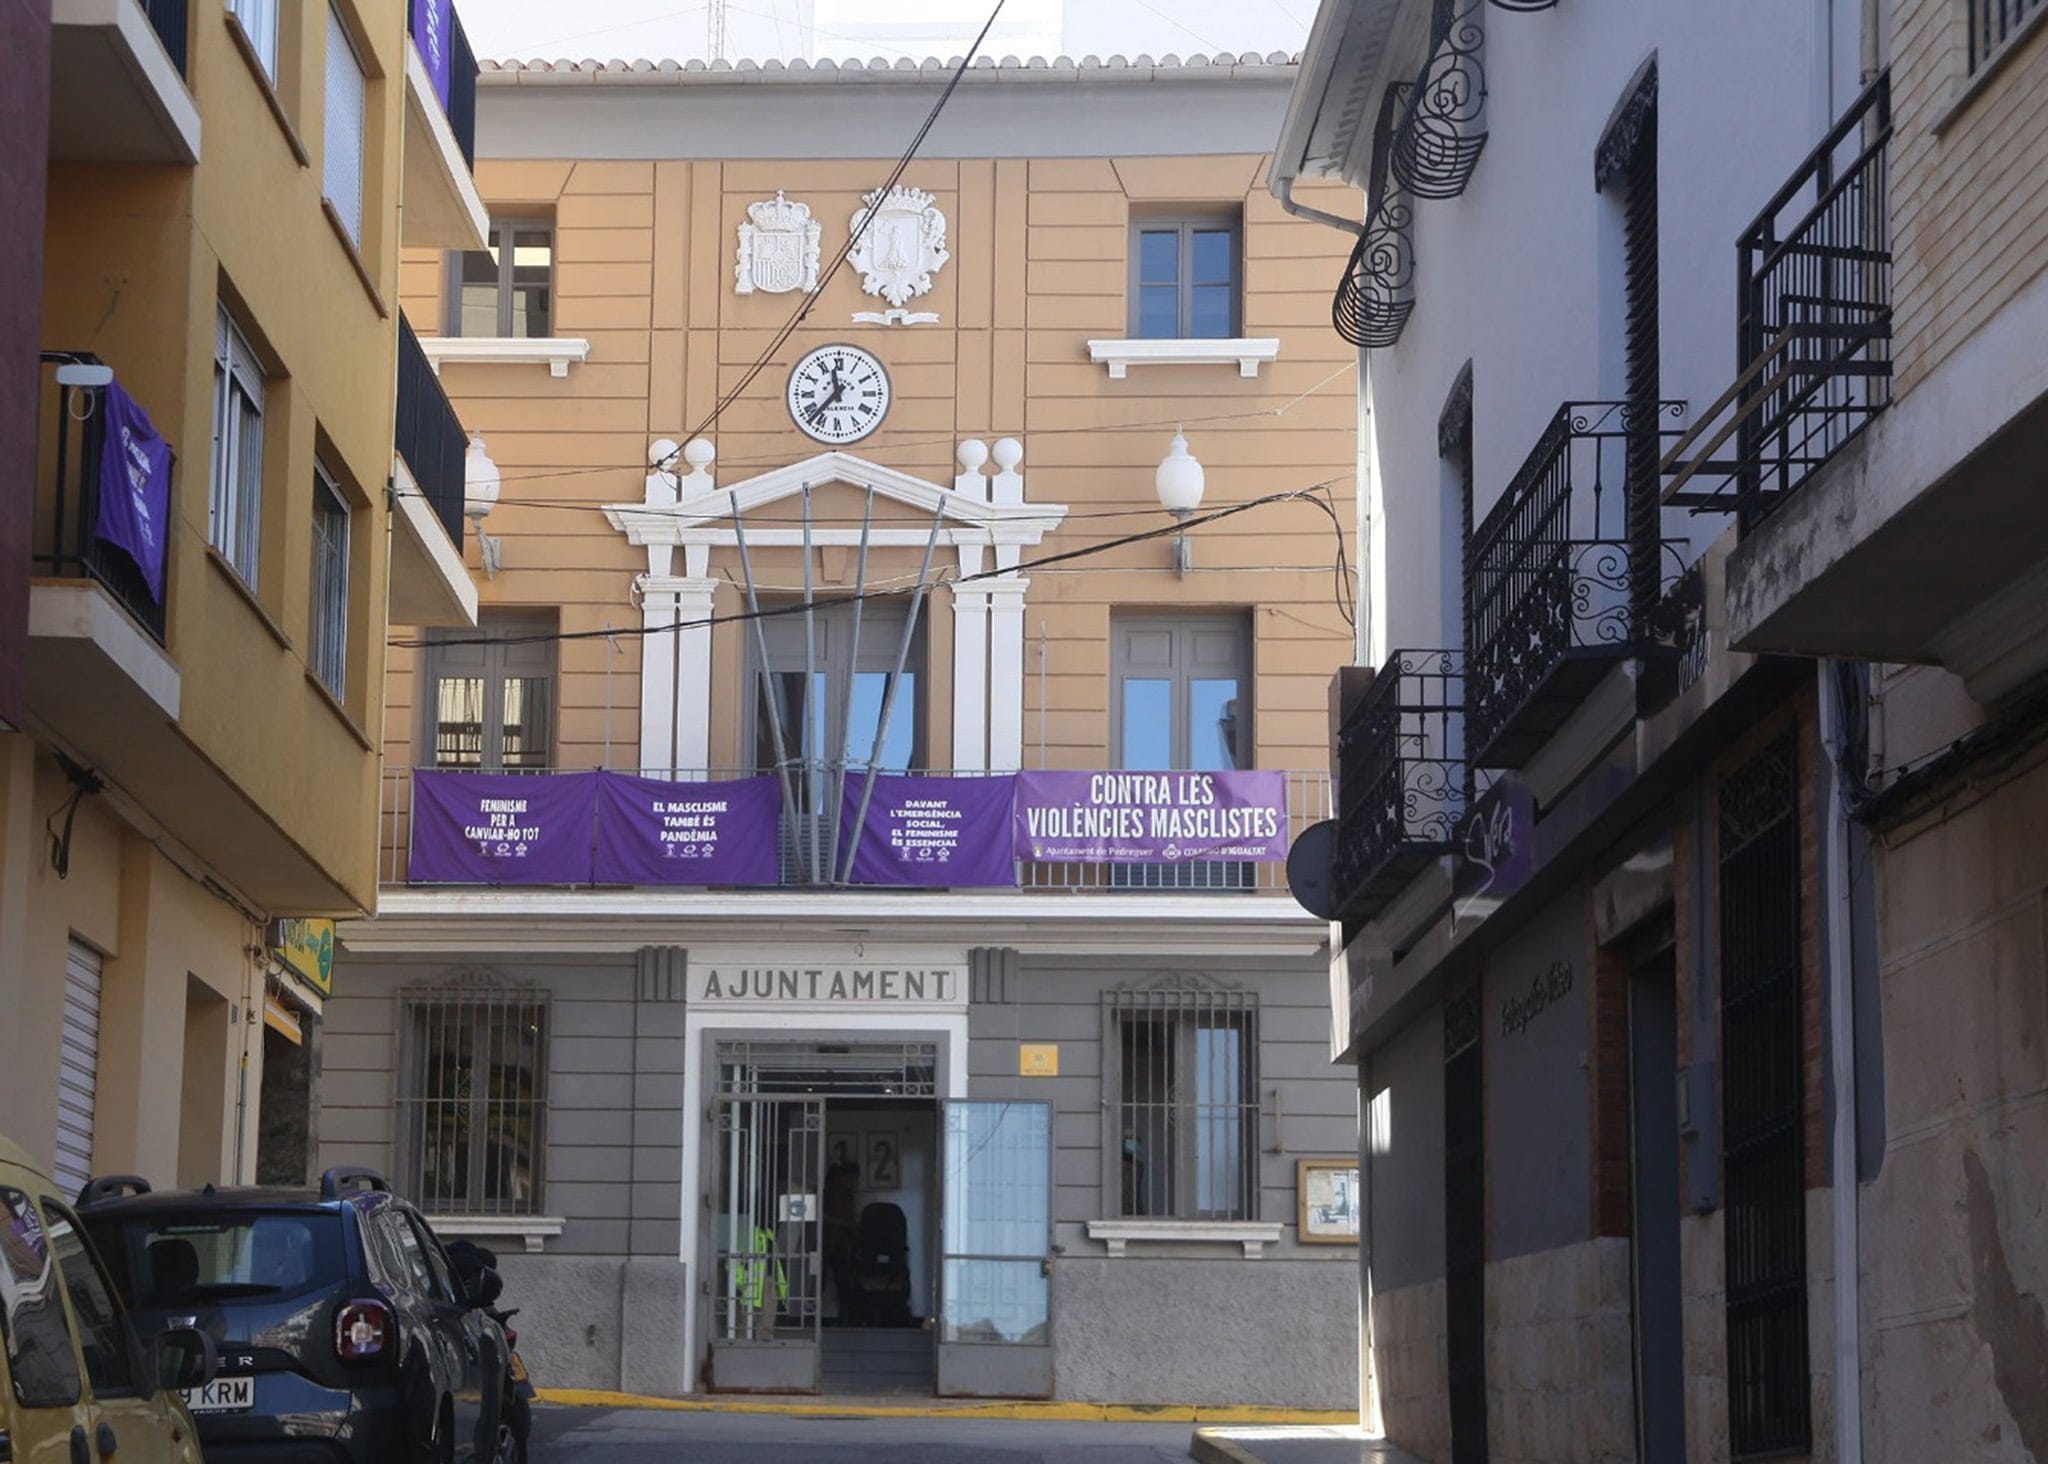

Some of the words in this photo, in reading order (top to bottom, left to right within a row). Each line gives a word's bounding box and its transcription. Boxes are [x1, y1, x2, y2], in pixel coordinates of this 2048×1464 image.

[1091, 775, 1171, 805] CONTRA
[1179, 775, 1214, 805] LES
[480, 799, 527, 812] FEMINISME
[653, 801, 665, 812] EL
[667, 801, 728, 812] MASCLISME
[905, 800, 948, 808] DAVANT
[490, 813, 507, 827] PER
[509, 813, 516, 827] A
[1027, 803, 1144, 838] VIOLÈNCIES
[1151, 807, 1278, 838] MASCLISTES
[464, 825, 520, 840] CANVIAR-HO
[522, 826, 540, 841] TOT
[891, 829, 903, 837] EL
[905, 839, 958, 847] ESSENCIAL
[1046, 847, 1095, 857] Ajuntament
[1096, 847, 1107, 856] de
[704, 969, 950, 999] AJUNTAMENT
[201, 1381, 248, 1405] KRM
